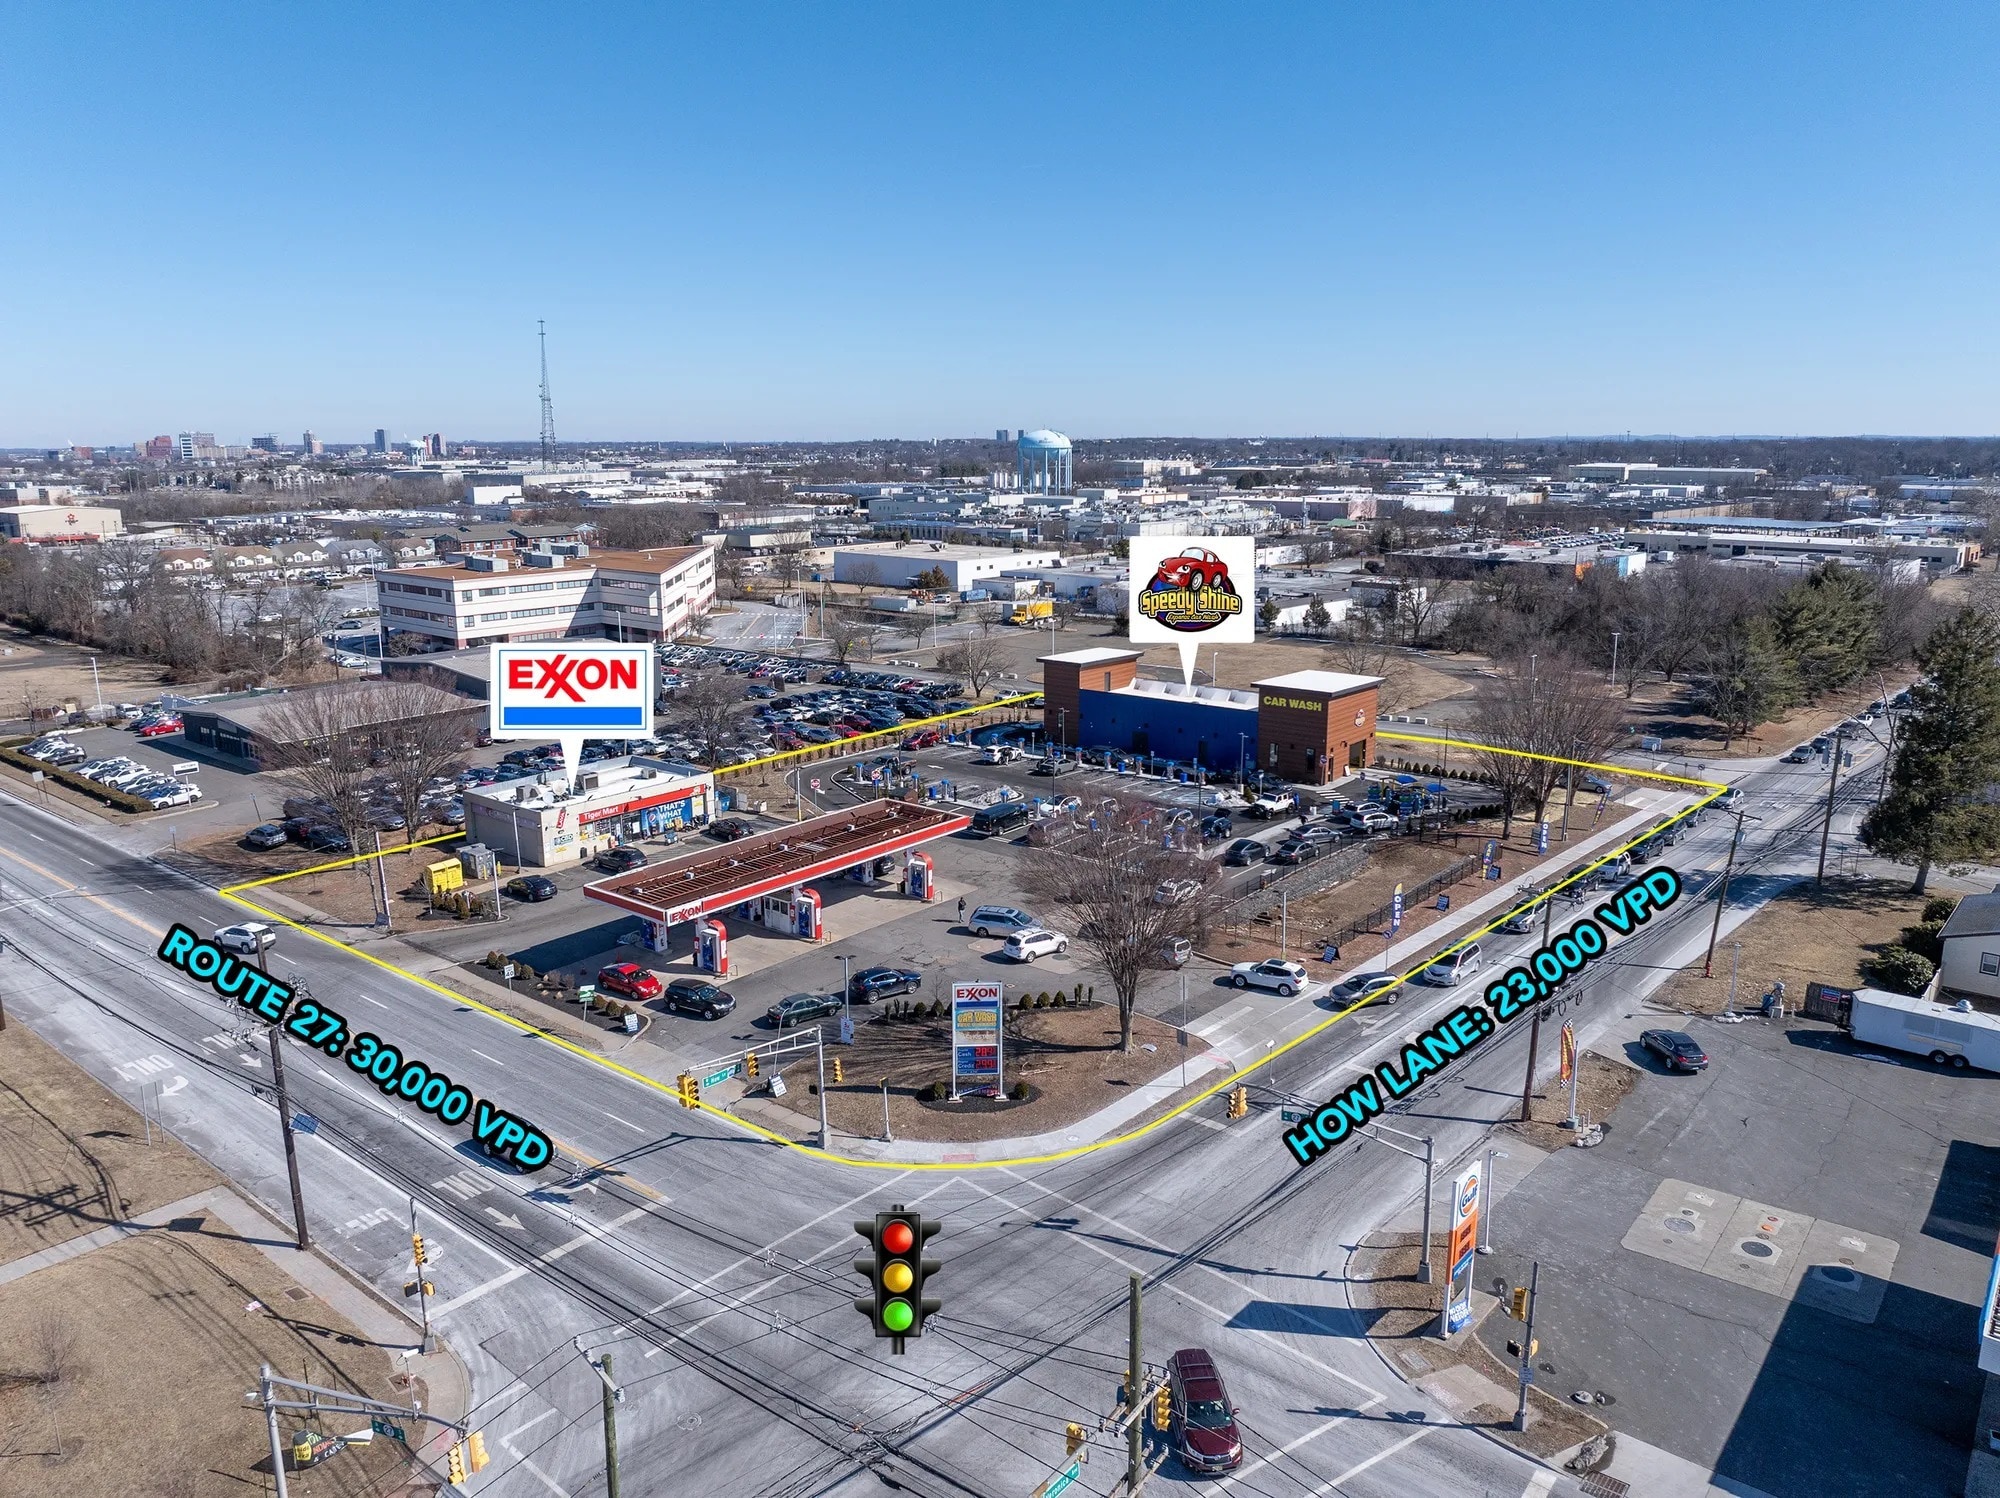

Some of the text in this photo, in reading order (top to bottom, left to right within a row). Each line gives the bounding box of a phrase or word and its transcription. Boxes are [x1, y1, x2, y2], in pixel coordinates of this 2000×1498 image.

[1263, 696, 1322, 712] CAR WASH
[583, 805, 619, 821] Tiger Mart
[658, 800, 686, 812] THAT'S
[660, 809, 683, 820] WHAT
[1541, 823, 1549, 849] OPEN
[670, 904, 702, 922] EXXON
[1393, 895, 1402, 926] OPEN
[956, 987, 998, 1001] EXXON
[1461, 1187, 1478, 1208] Gulf
